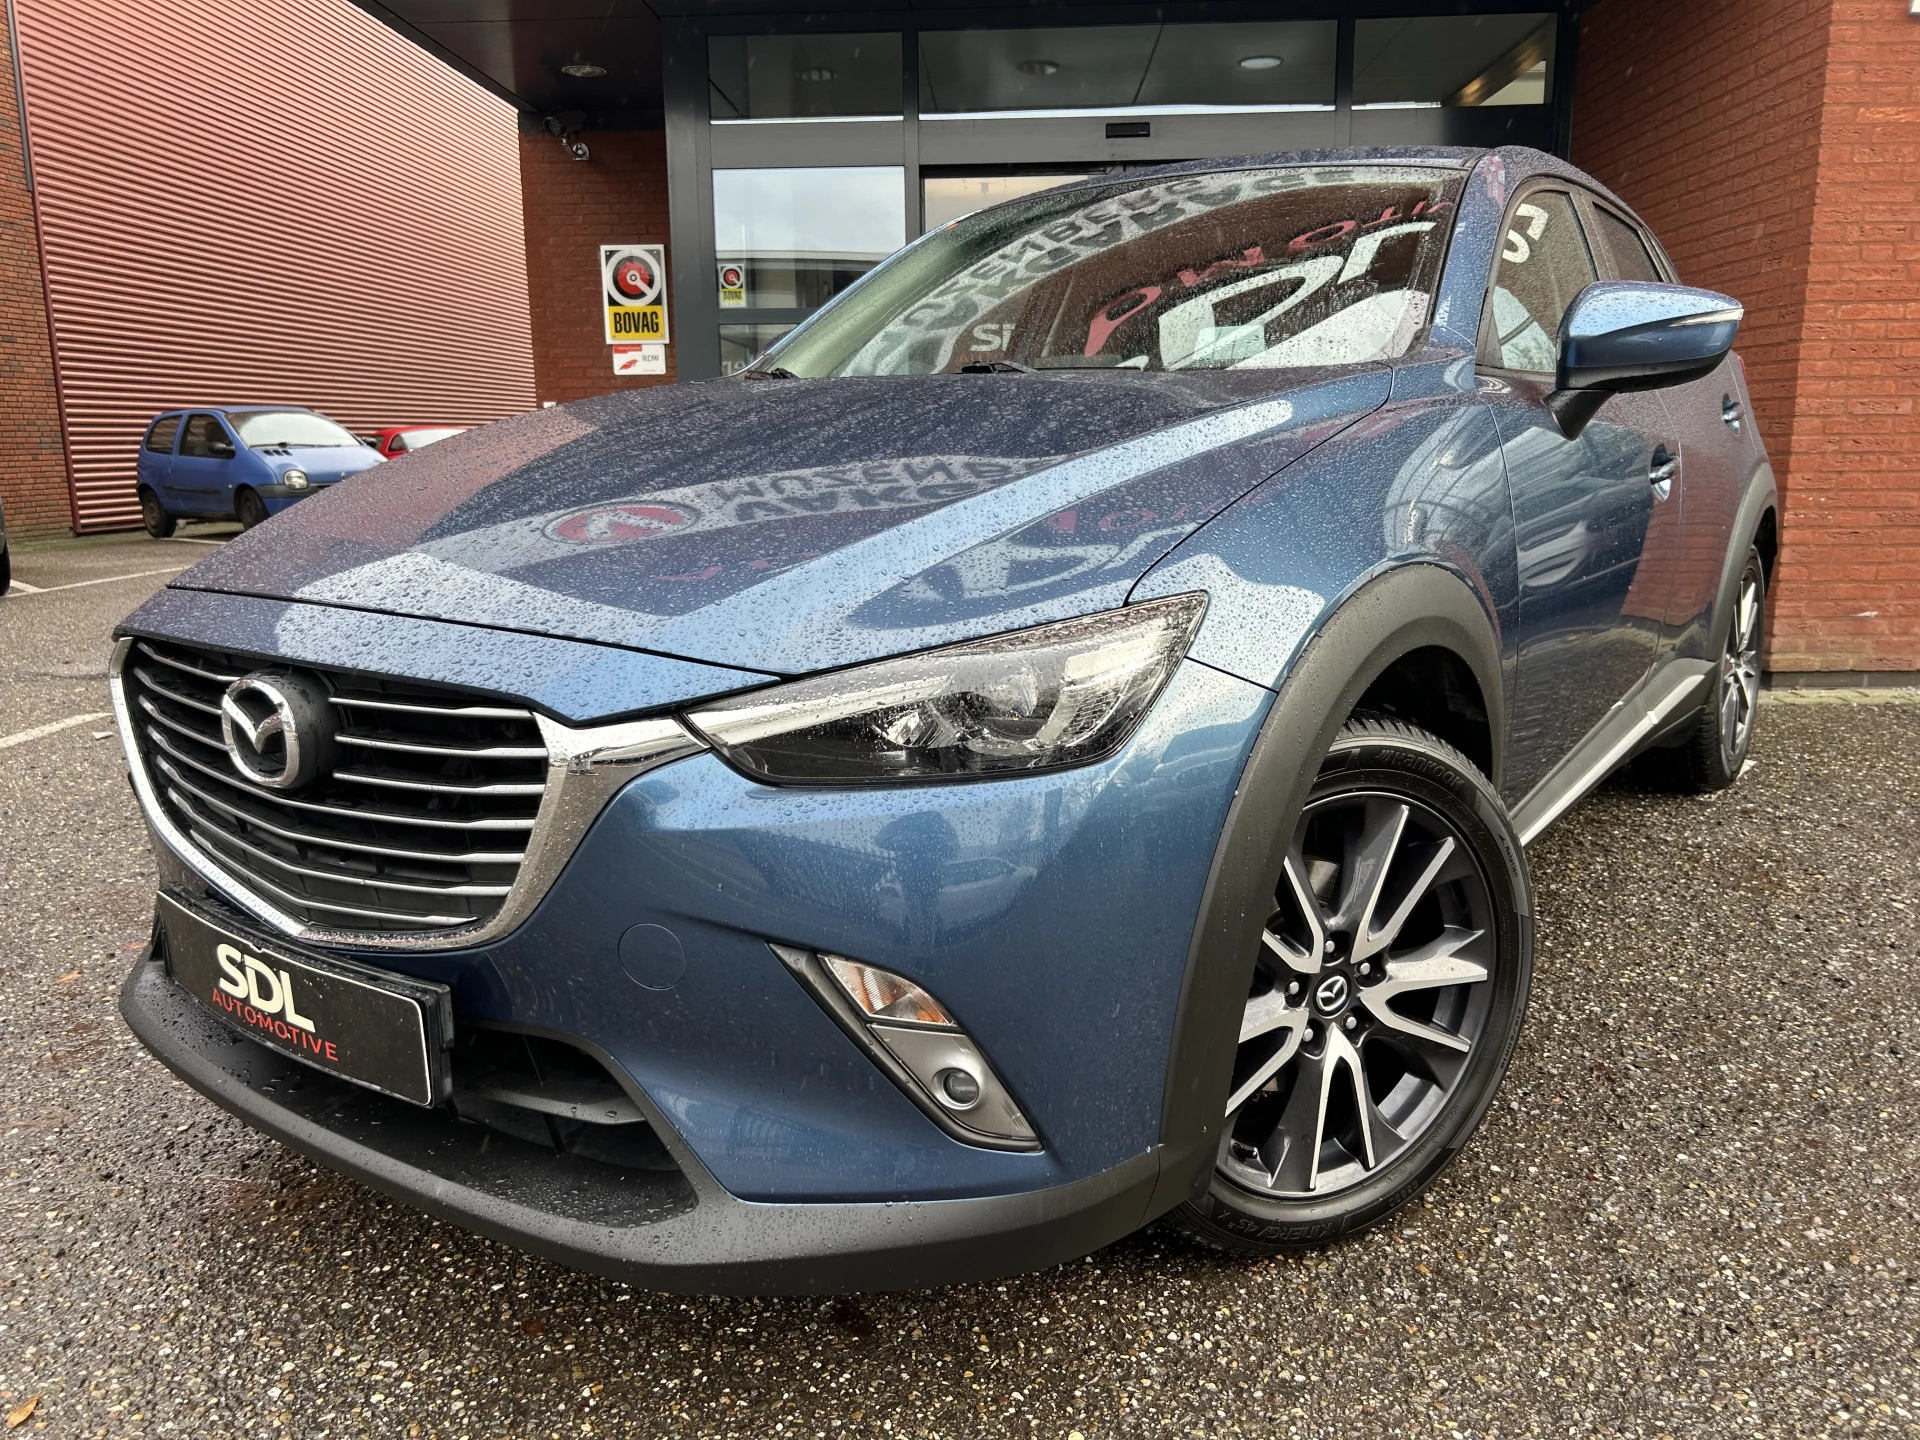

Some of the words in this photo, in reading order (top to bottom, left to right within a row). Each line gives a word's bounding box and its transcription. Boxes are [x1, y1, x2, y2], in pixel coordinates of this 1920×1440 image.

[723, 290, 742, 301] BOVAG
[615, 311, 659, 334] BOVAG
[642, 354, 660, 362] RDW
[1504, 844, 1519, 878] Rotation
[216, 943, 316, 1033] SDL
[212, 987, 339, 1062] AUTOMOTIVE
